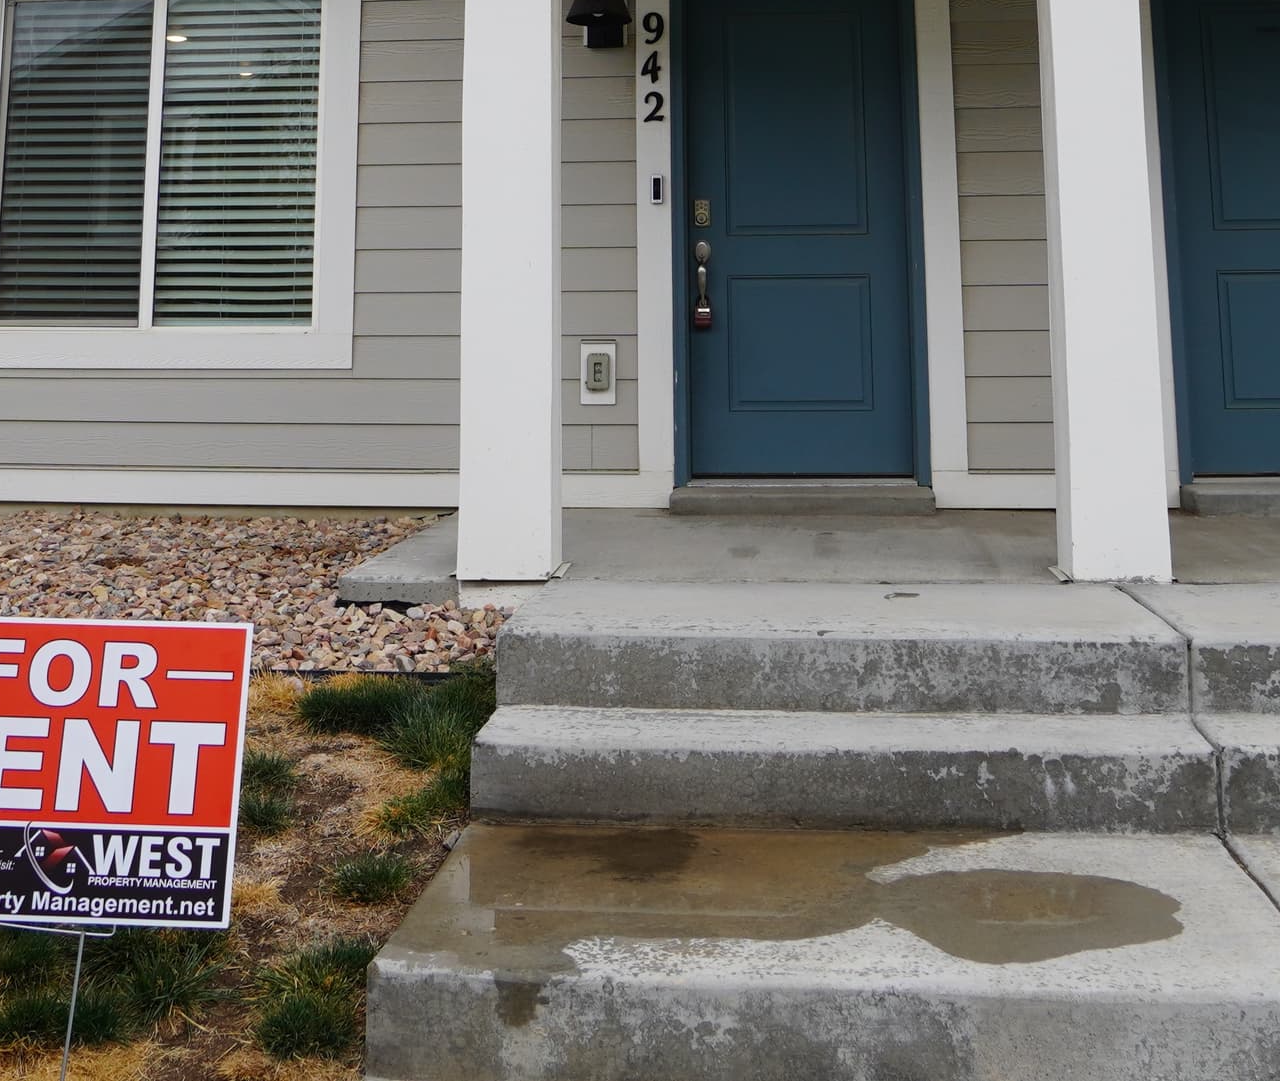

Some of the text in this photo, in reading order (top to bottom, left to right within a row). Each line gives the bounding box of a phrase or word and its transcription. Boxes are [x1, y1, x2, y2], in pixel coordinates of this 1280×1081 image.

[641, 12, 664, 122] 942
[92, 834, 221, 879] WEST
[88, 877, 217, 890] PROPERTY MANAGEMENT
[31, 891, 215, 917] Management.net
